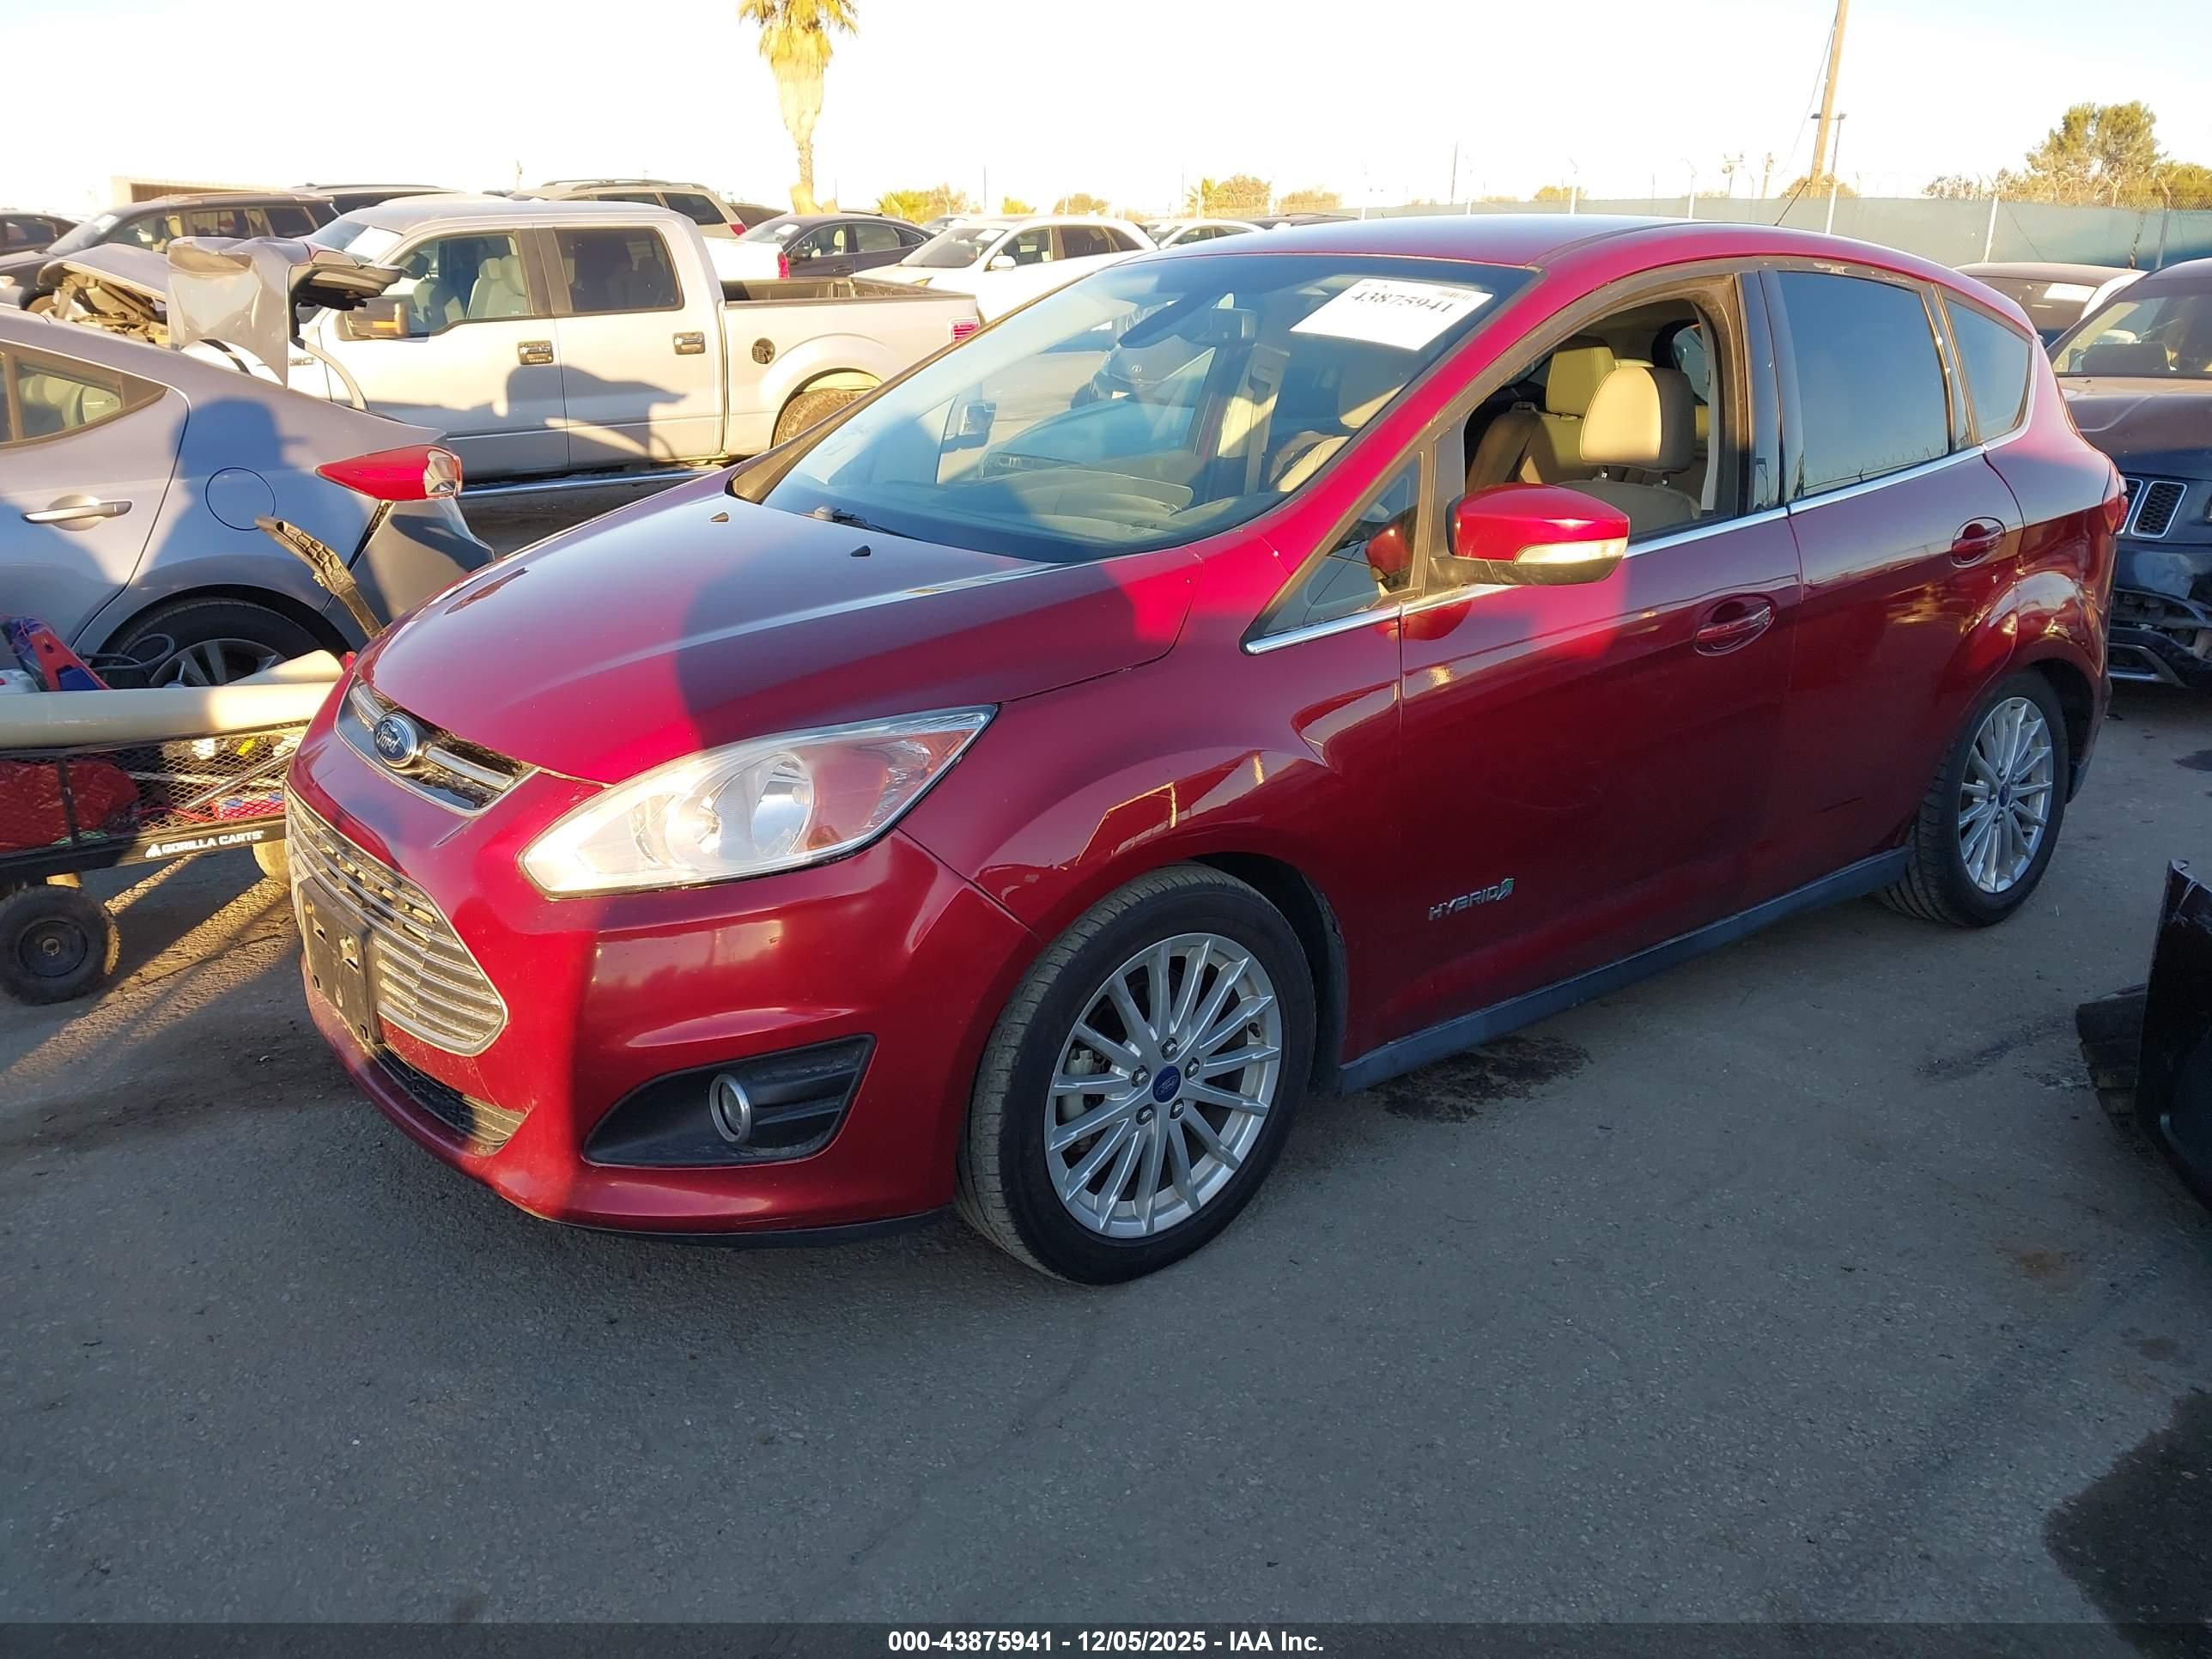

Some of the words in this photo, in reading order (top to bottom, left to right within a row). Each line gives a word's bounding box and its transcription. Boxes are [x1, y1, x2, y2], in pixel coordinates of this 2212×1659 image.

[1351, 291, 1455, 313] 43875941
[376, 721, 401, 754] Ford
[161, 838, 216, 854] GORILLA
[218, 830, 263, 845] CARTS
[1428, 884, 1499, 921] HYBRID
